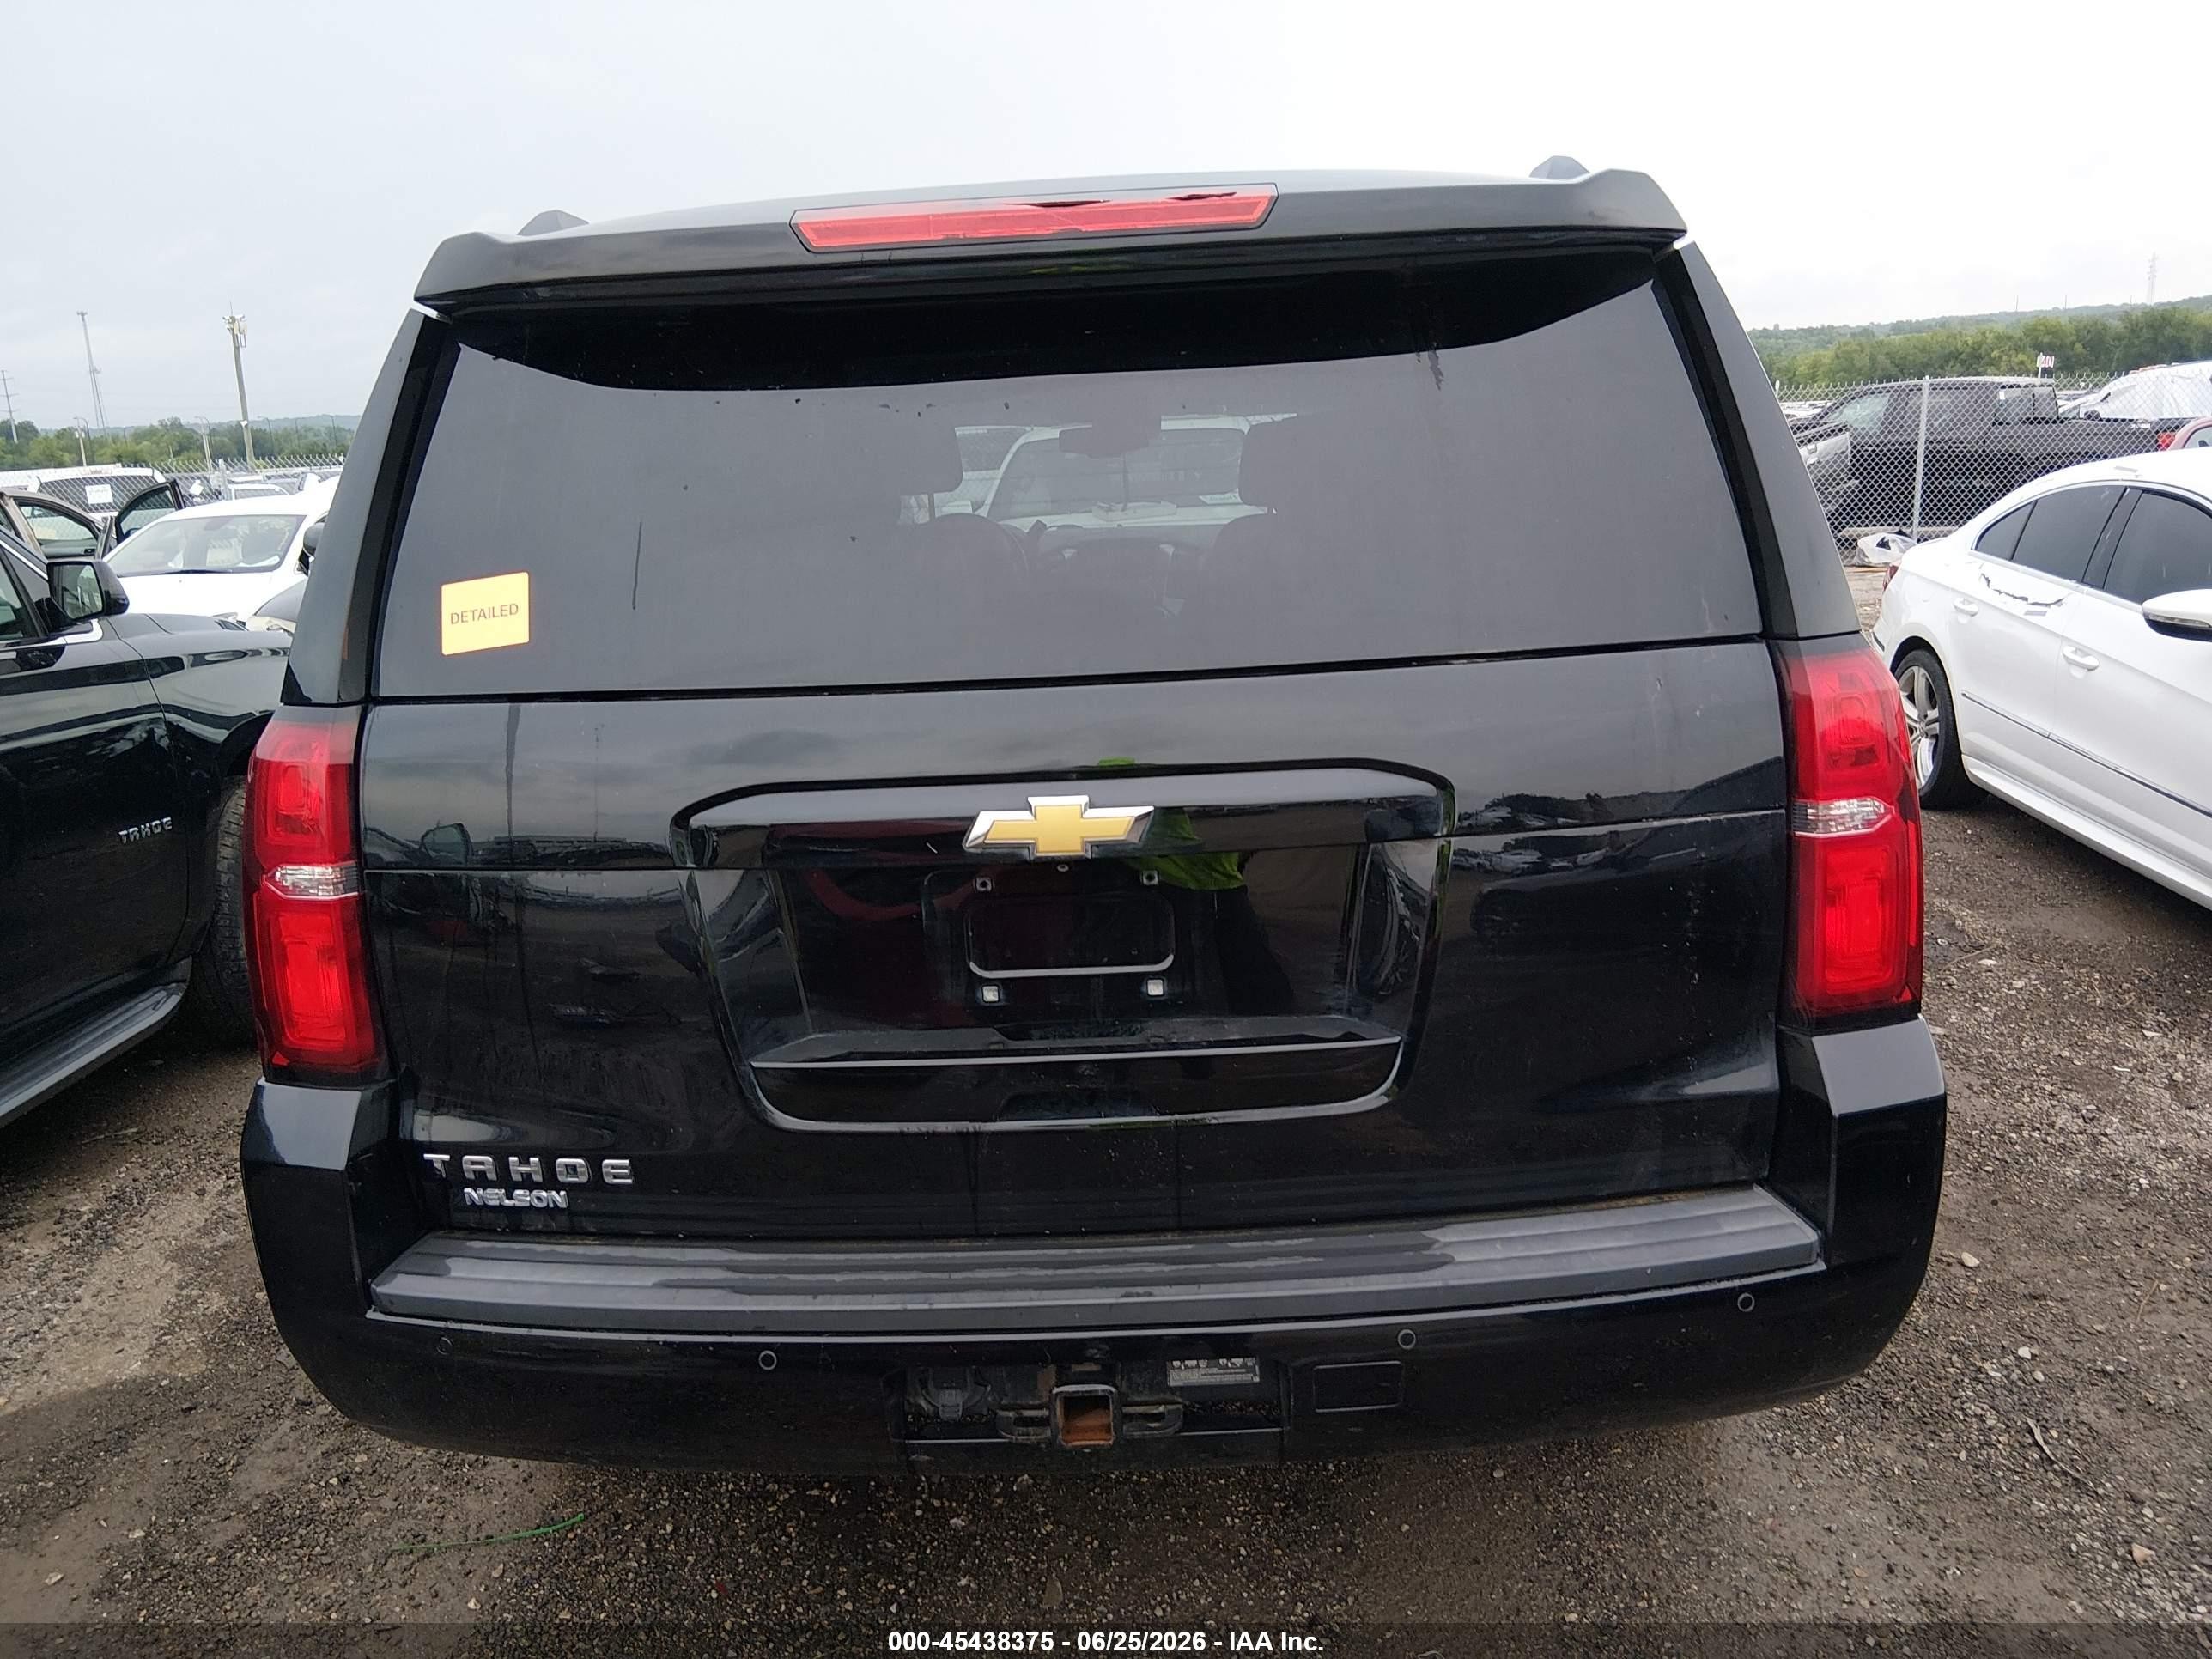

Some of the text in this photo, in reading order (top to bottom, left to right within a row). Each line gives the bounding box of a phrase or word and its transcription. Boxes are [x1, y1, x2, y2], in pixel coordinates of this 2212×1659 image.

[451, 603, 519, 625] DETAILED
[118, 817, 173, 845] TAHOE
[423, 1153, 633, 1185] TAHOE
[463, 1188, 568, 1209] NELSON
